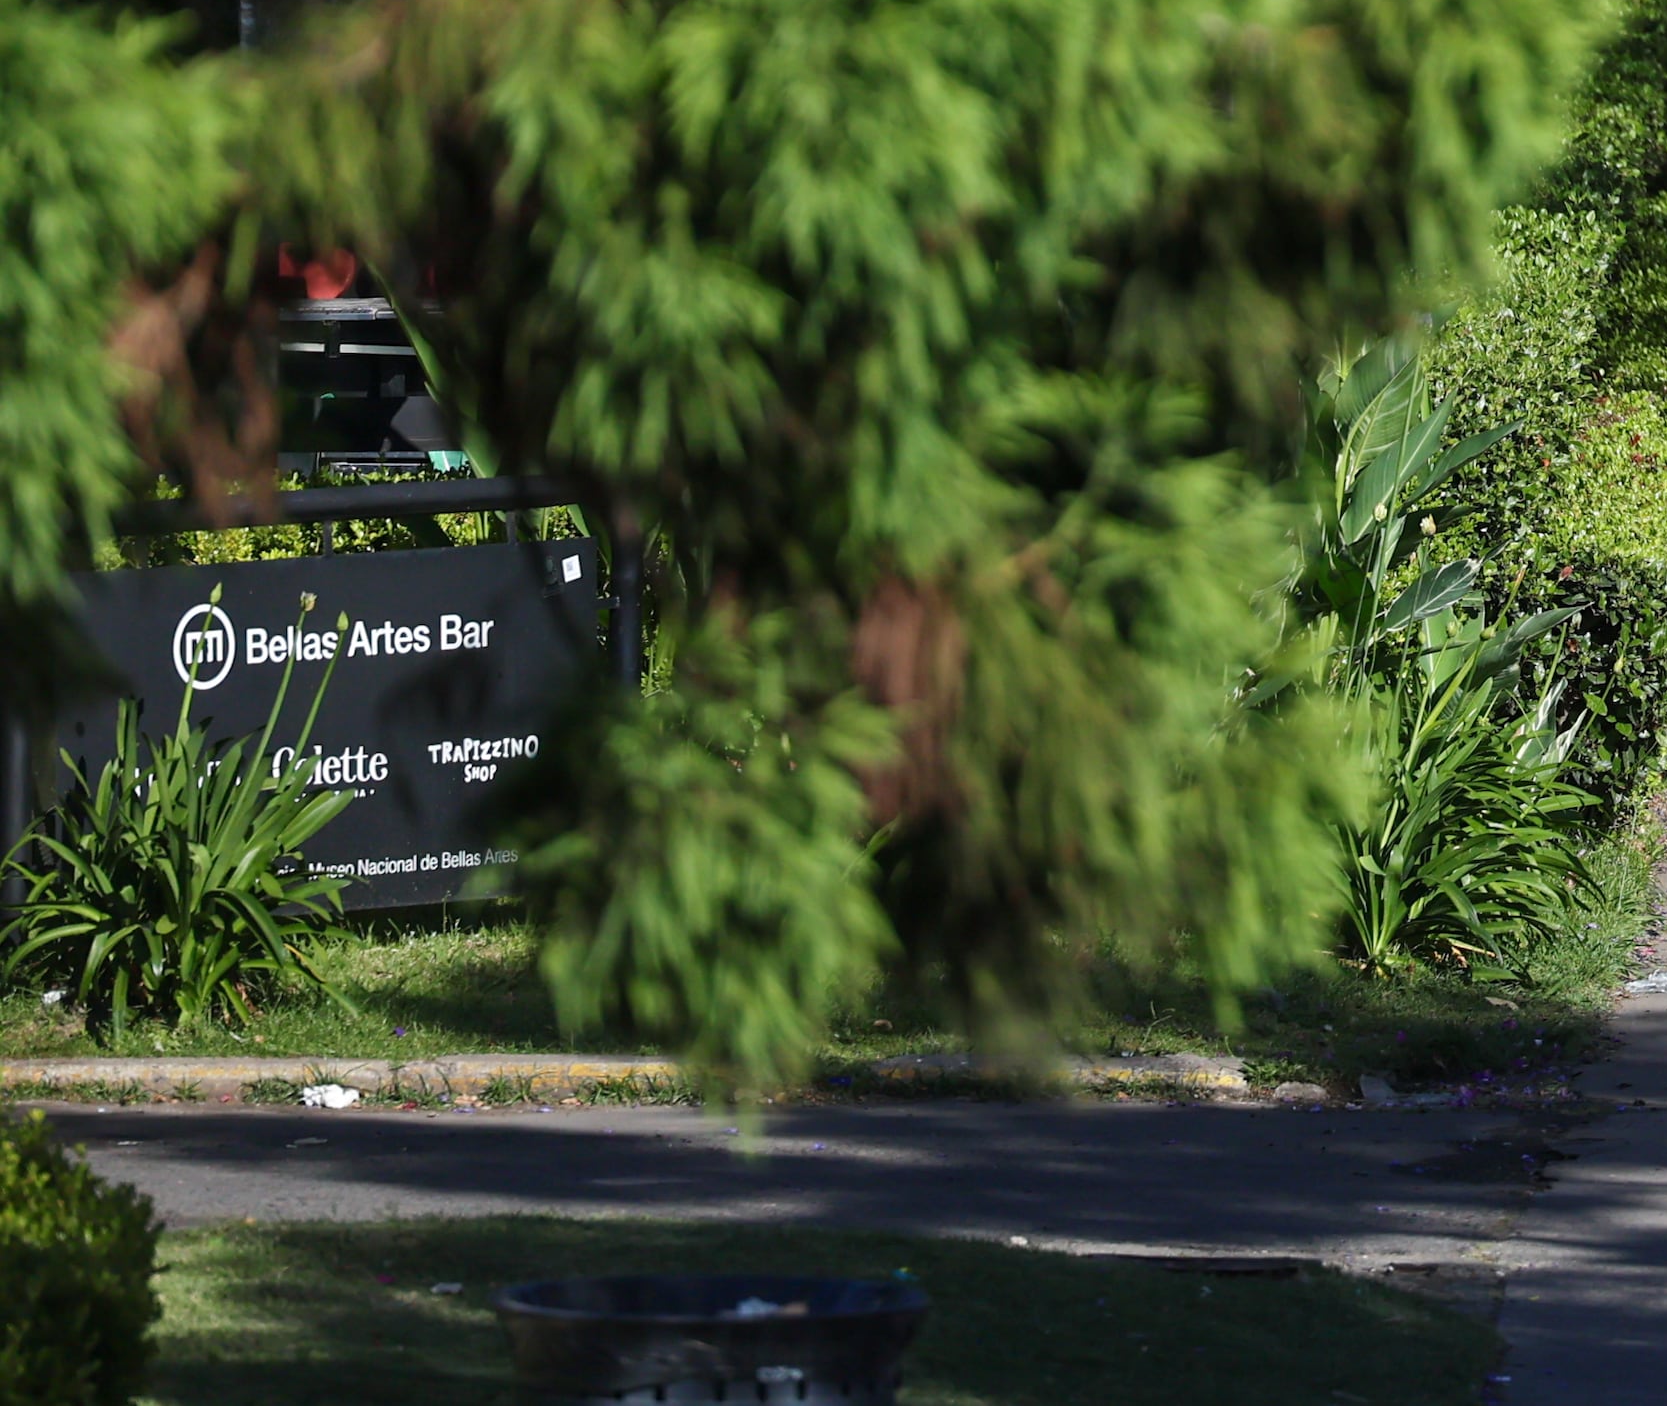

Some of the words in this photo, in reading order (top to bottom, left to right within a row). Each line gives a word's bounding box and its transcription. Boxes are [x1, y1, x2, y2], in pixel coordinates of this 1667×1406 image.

[246, 625, 339, 665] Bellas
[347, 620, 431, 658] Artes
[440, 614, 494, 651] Bar
[428, 735, 539, 764] TRAPIZZINO
[464, 763, 497, 783] SHOP
[357, 856, 417, 876] Nacional
[420, 853, 439, 871] de
[441, 850, 481, 869] Bellas
[484, 847, 519, 865] Artes
